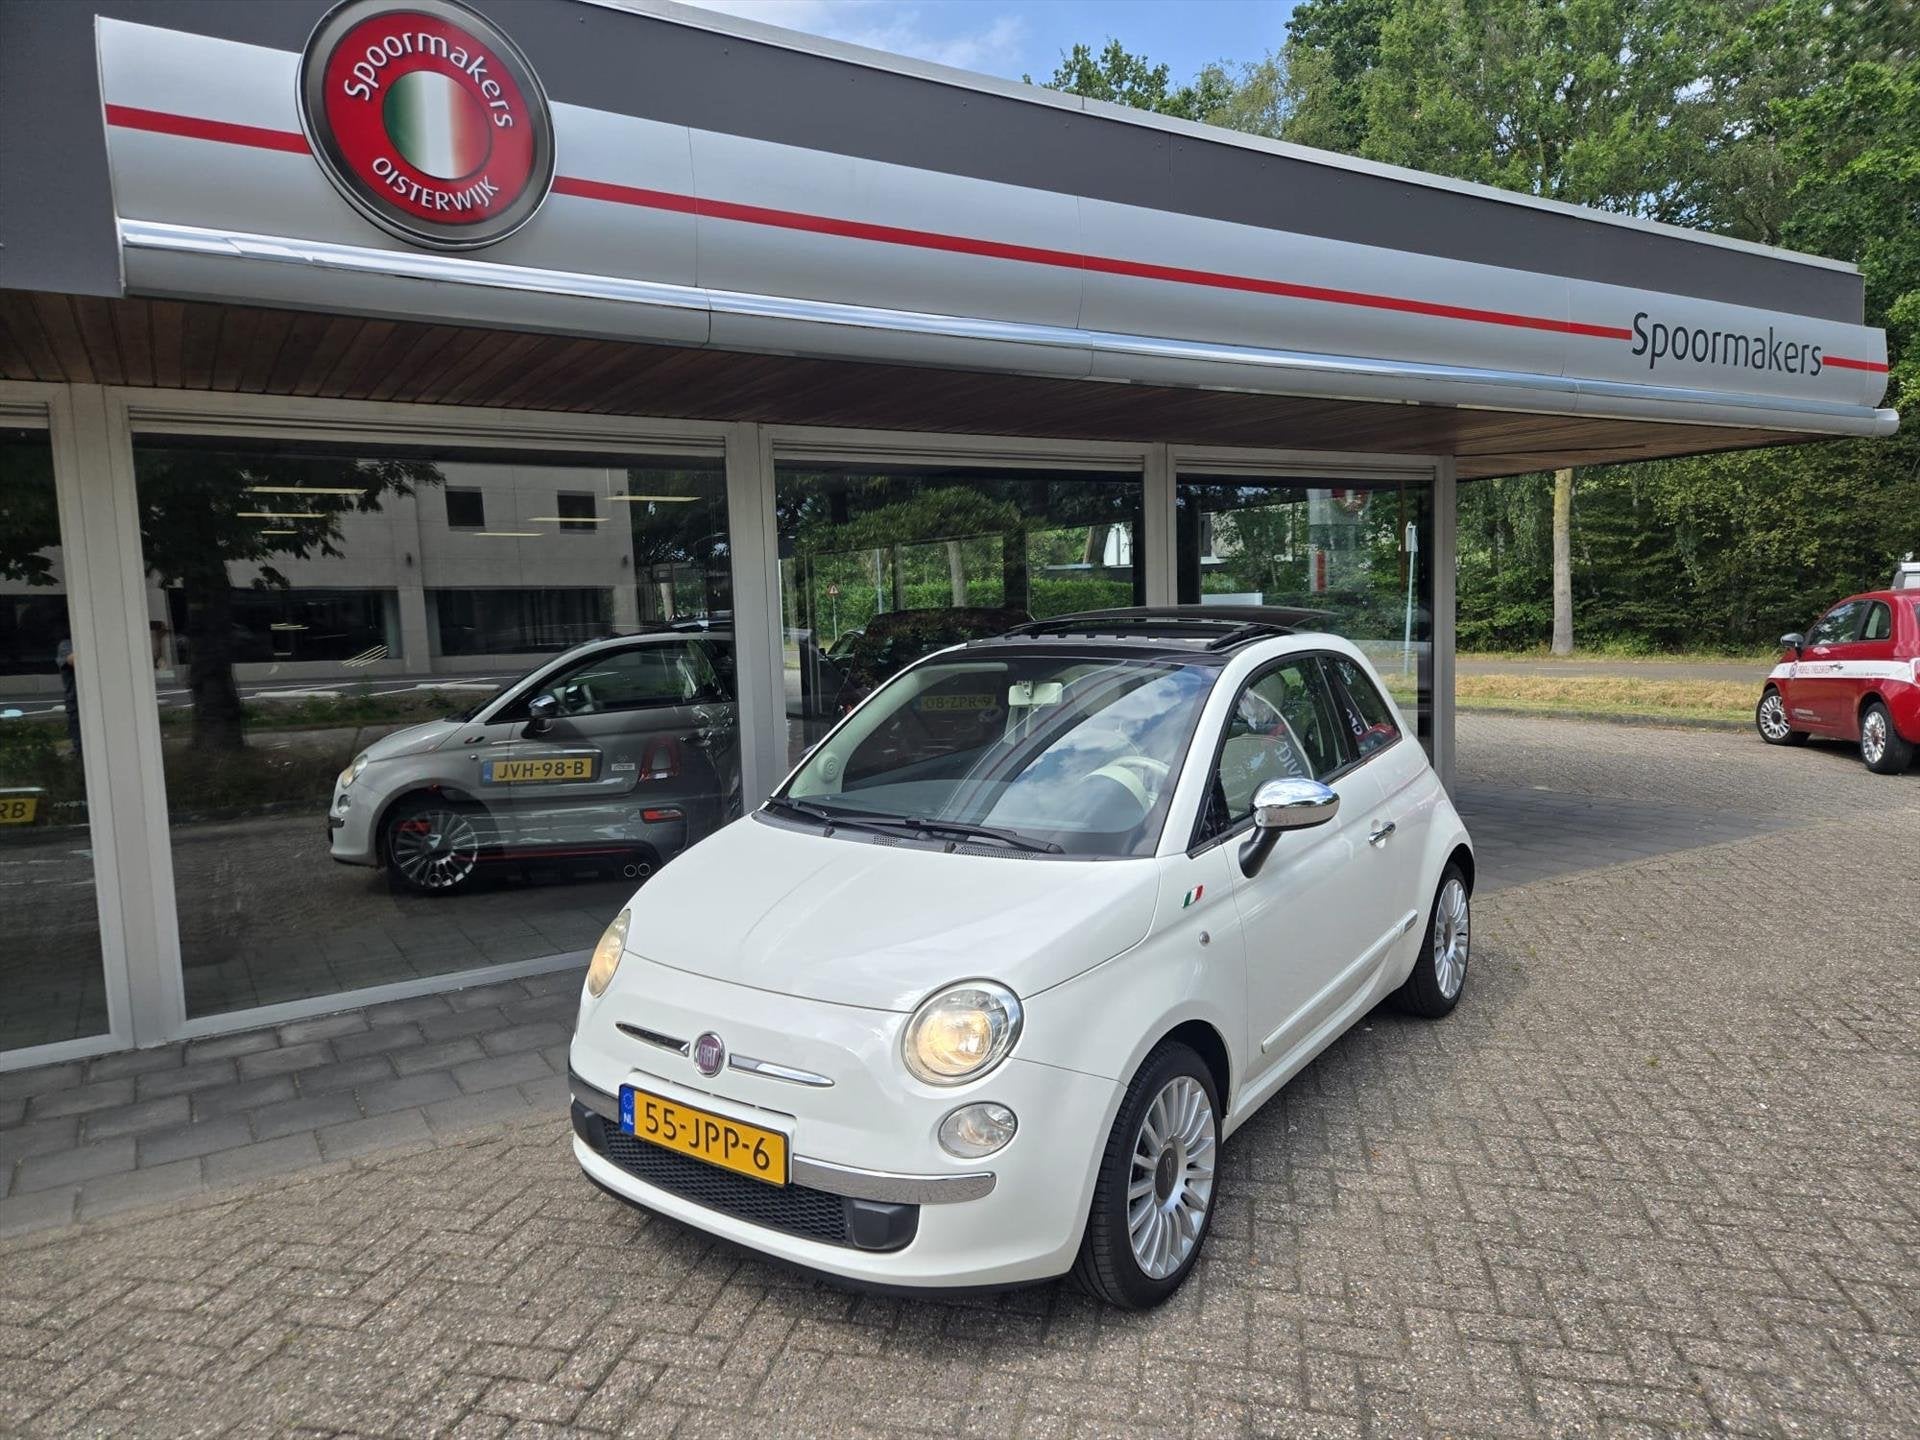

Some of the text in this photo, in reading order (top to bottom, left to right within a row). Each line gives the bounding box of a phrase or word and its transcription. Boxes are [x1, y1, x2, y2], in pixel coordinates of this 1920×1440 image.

[344, 32, 513, 129] Spoormakers
[372, 157, 499, 211] OISTERWIJK
[1631, 311, 1823, 376] Spoormakers
[498, 761, 585, 779] JVH-98-B
[623, 1112, 634, 1125] NL
[645, 1101, 770, 1171] 55-JPP-6
